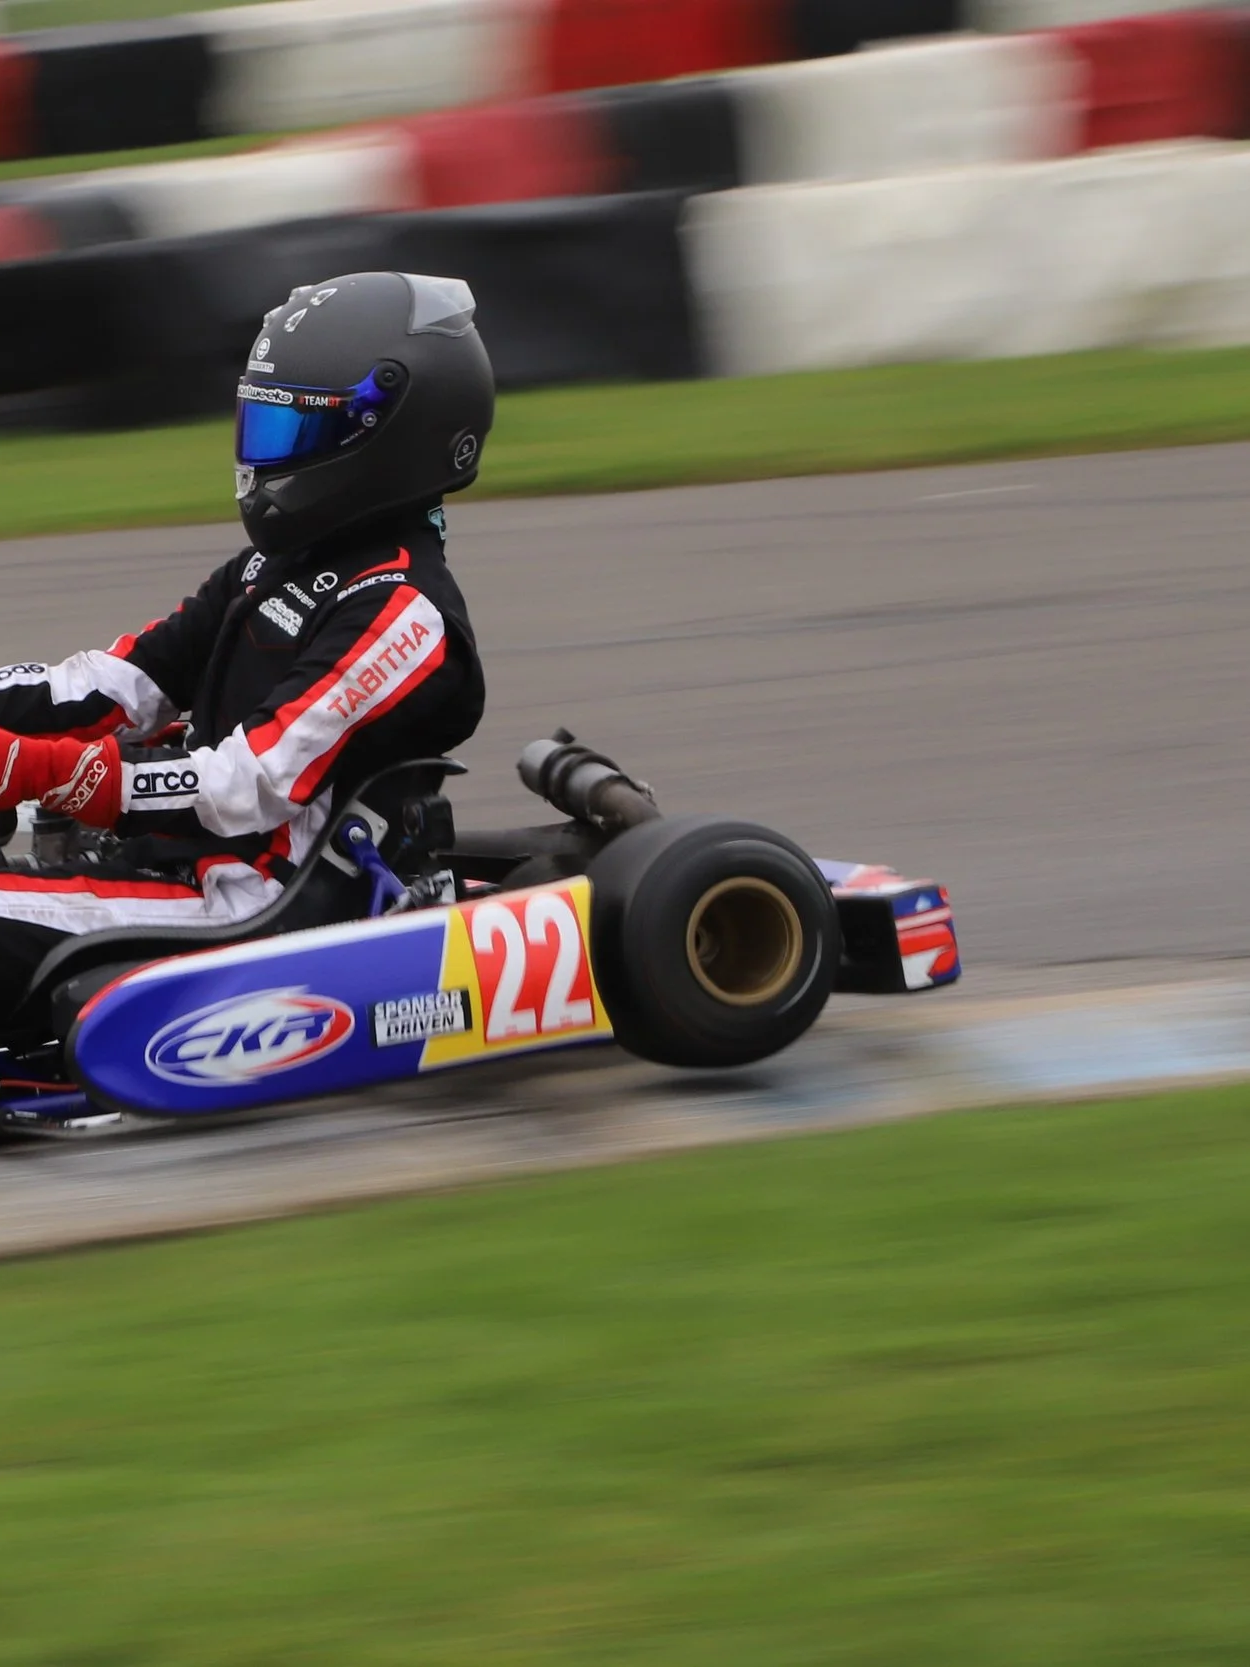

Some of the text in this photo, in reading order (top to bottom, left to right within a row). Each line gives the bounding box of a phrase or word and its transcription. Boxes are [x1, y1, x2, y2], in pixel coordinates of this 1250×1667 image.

[327, 621, 430, 719] TABITHA
[62, 760, 108, 813] sparco
[132, 770, 200, 799] arco
[471, 892, 593, 1040] 22
[375, 989, 461, 1020] SPONSOR
[386, 1011, 454, 1039] DRIVEN
